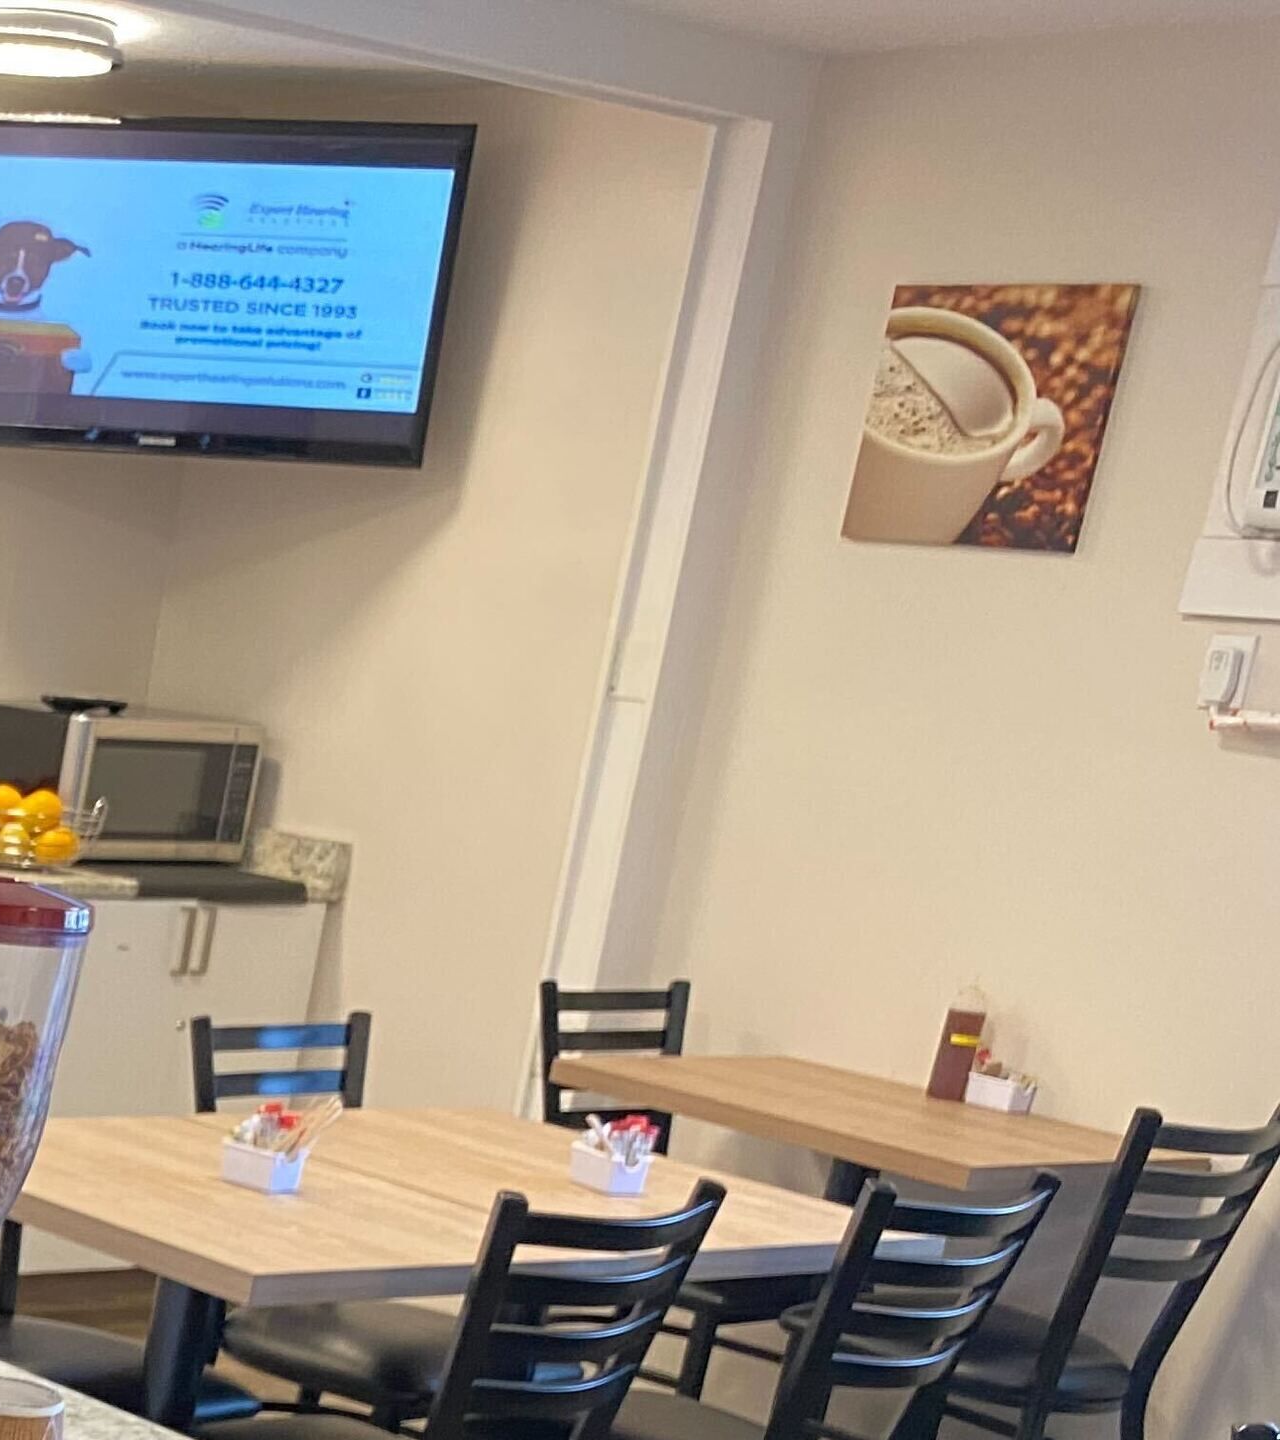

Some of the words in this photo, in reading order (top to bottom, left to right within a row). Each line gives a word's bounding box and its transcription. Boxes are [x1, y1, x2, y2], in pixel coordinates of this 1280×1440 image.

[277, 245, 348, 259] company
[171, 271, 344, 294] 1-888-644-4327
[148, 297, 239, 313] TRUSTED
[246, 301, 306, 317] SINCE
[314, 303, 358, 319] 1993
